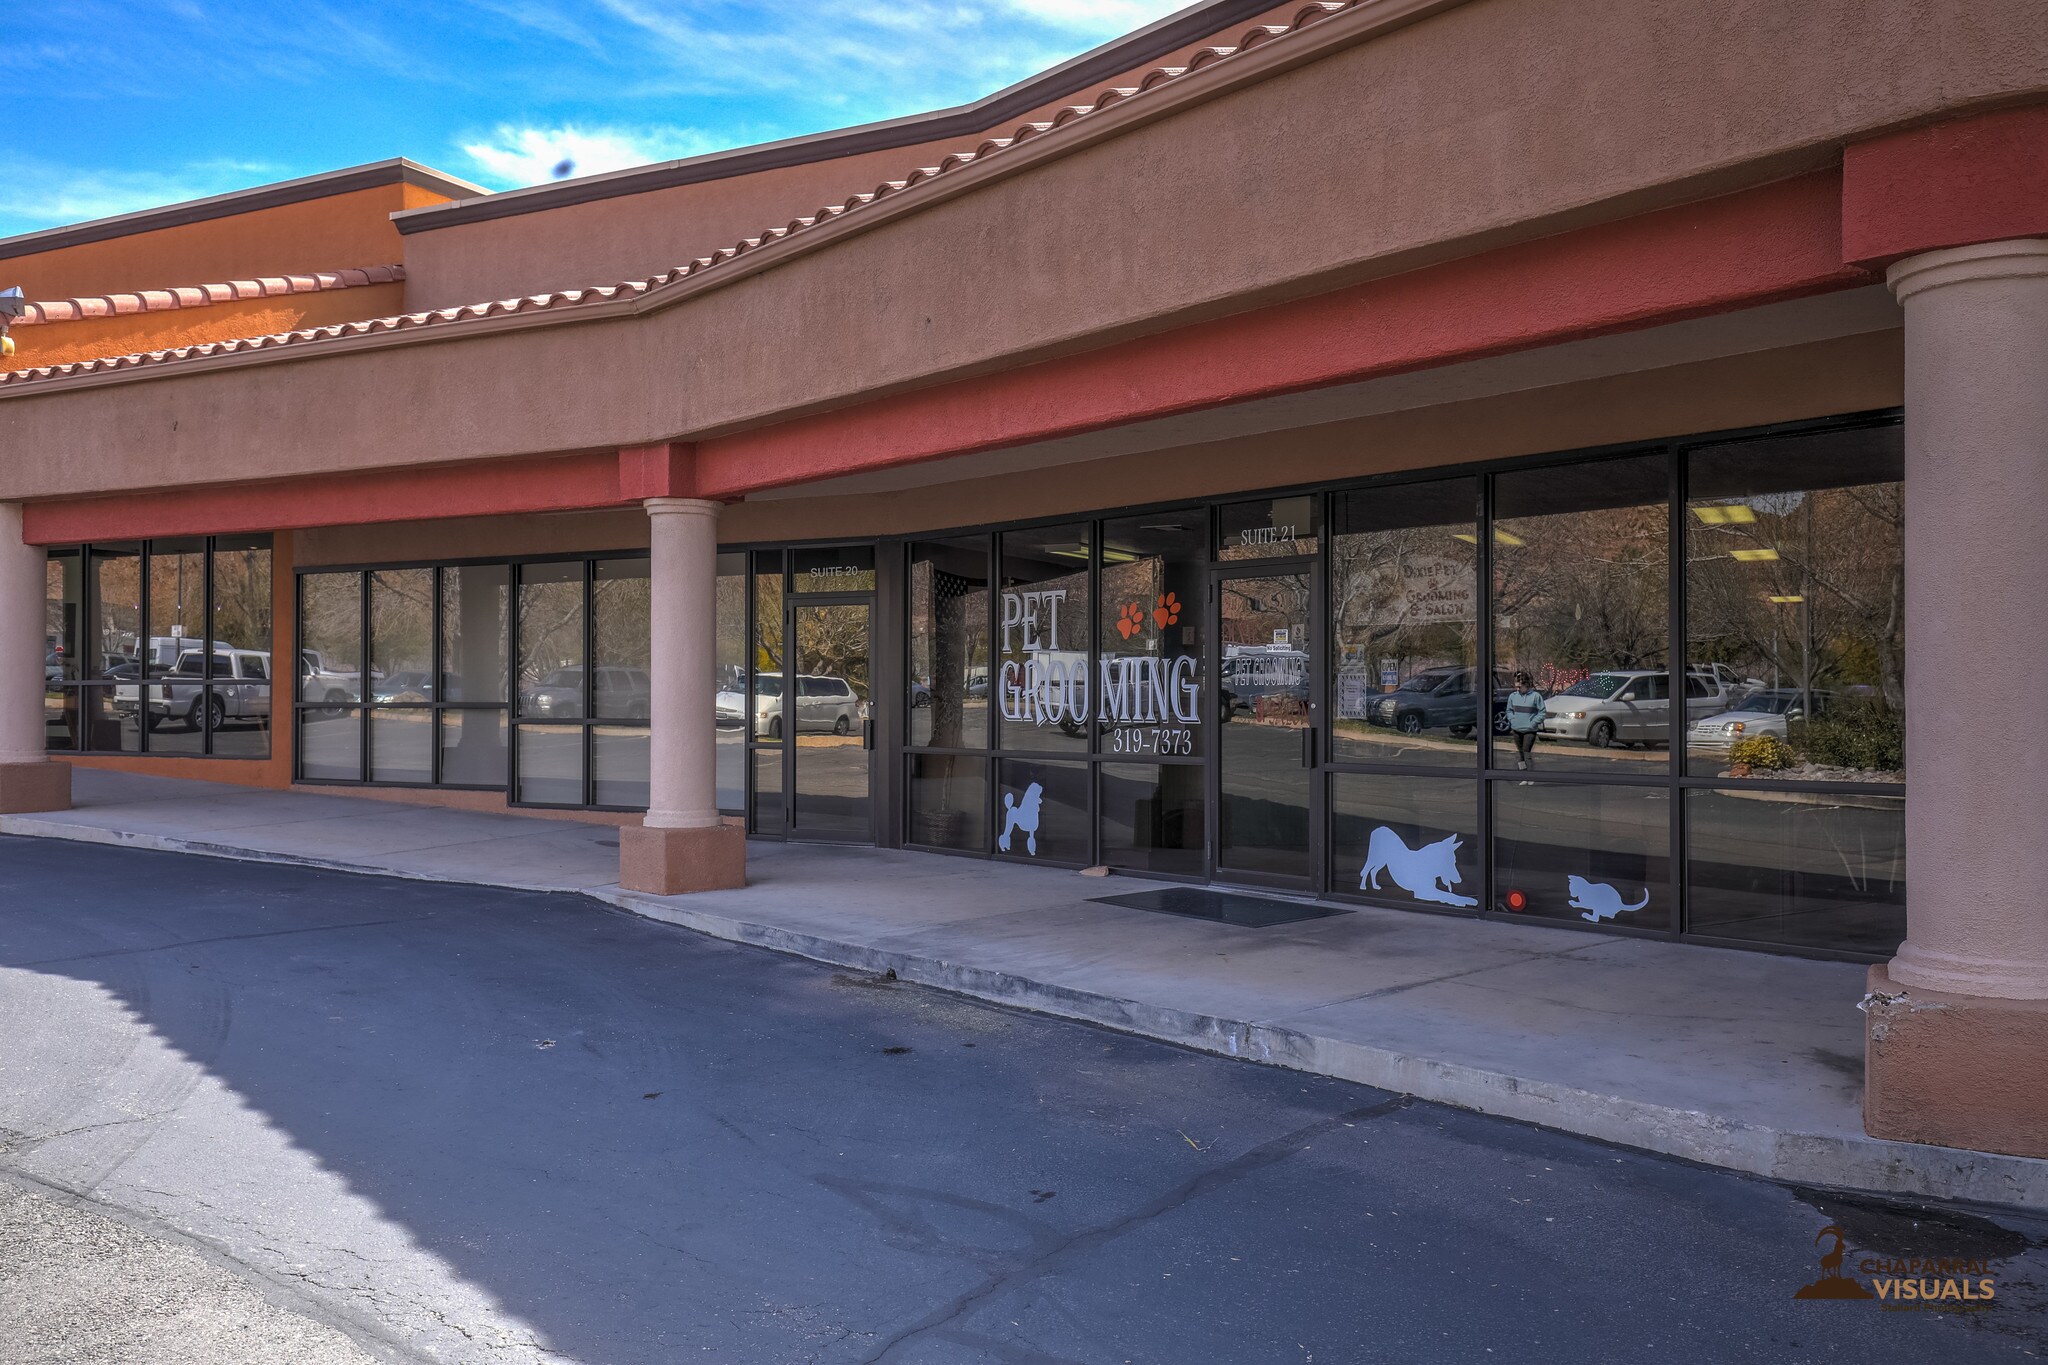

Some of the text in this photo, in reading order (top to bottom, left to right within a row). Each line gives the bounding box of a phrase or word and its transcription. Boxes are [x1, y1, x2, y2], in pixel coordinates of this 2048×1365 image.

[1241, 525, 1296, 546] SUITE 21
[810, 566, 858, 578] SUITE 20
[1001, 589, 1067, 653] PET
[1426, 603, 1464, 616] SALON
[1235, 657, 1301, 686] PET GROOMING
[1382, 662, 1398, 672] OPEN
[999, 655, 1202, 727] GROOMING
[1113, 729, 1192, 755] 319-7373
